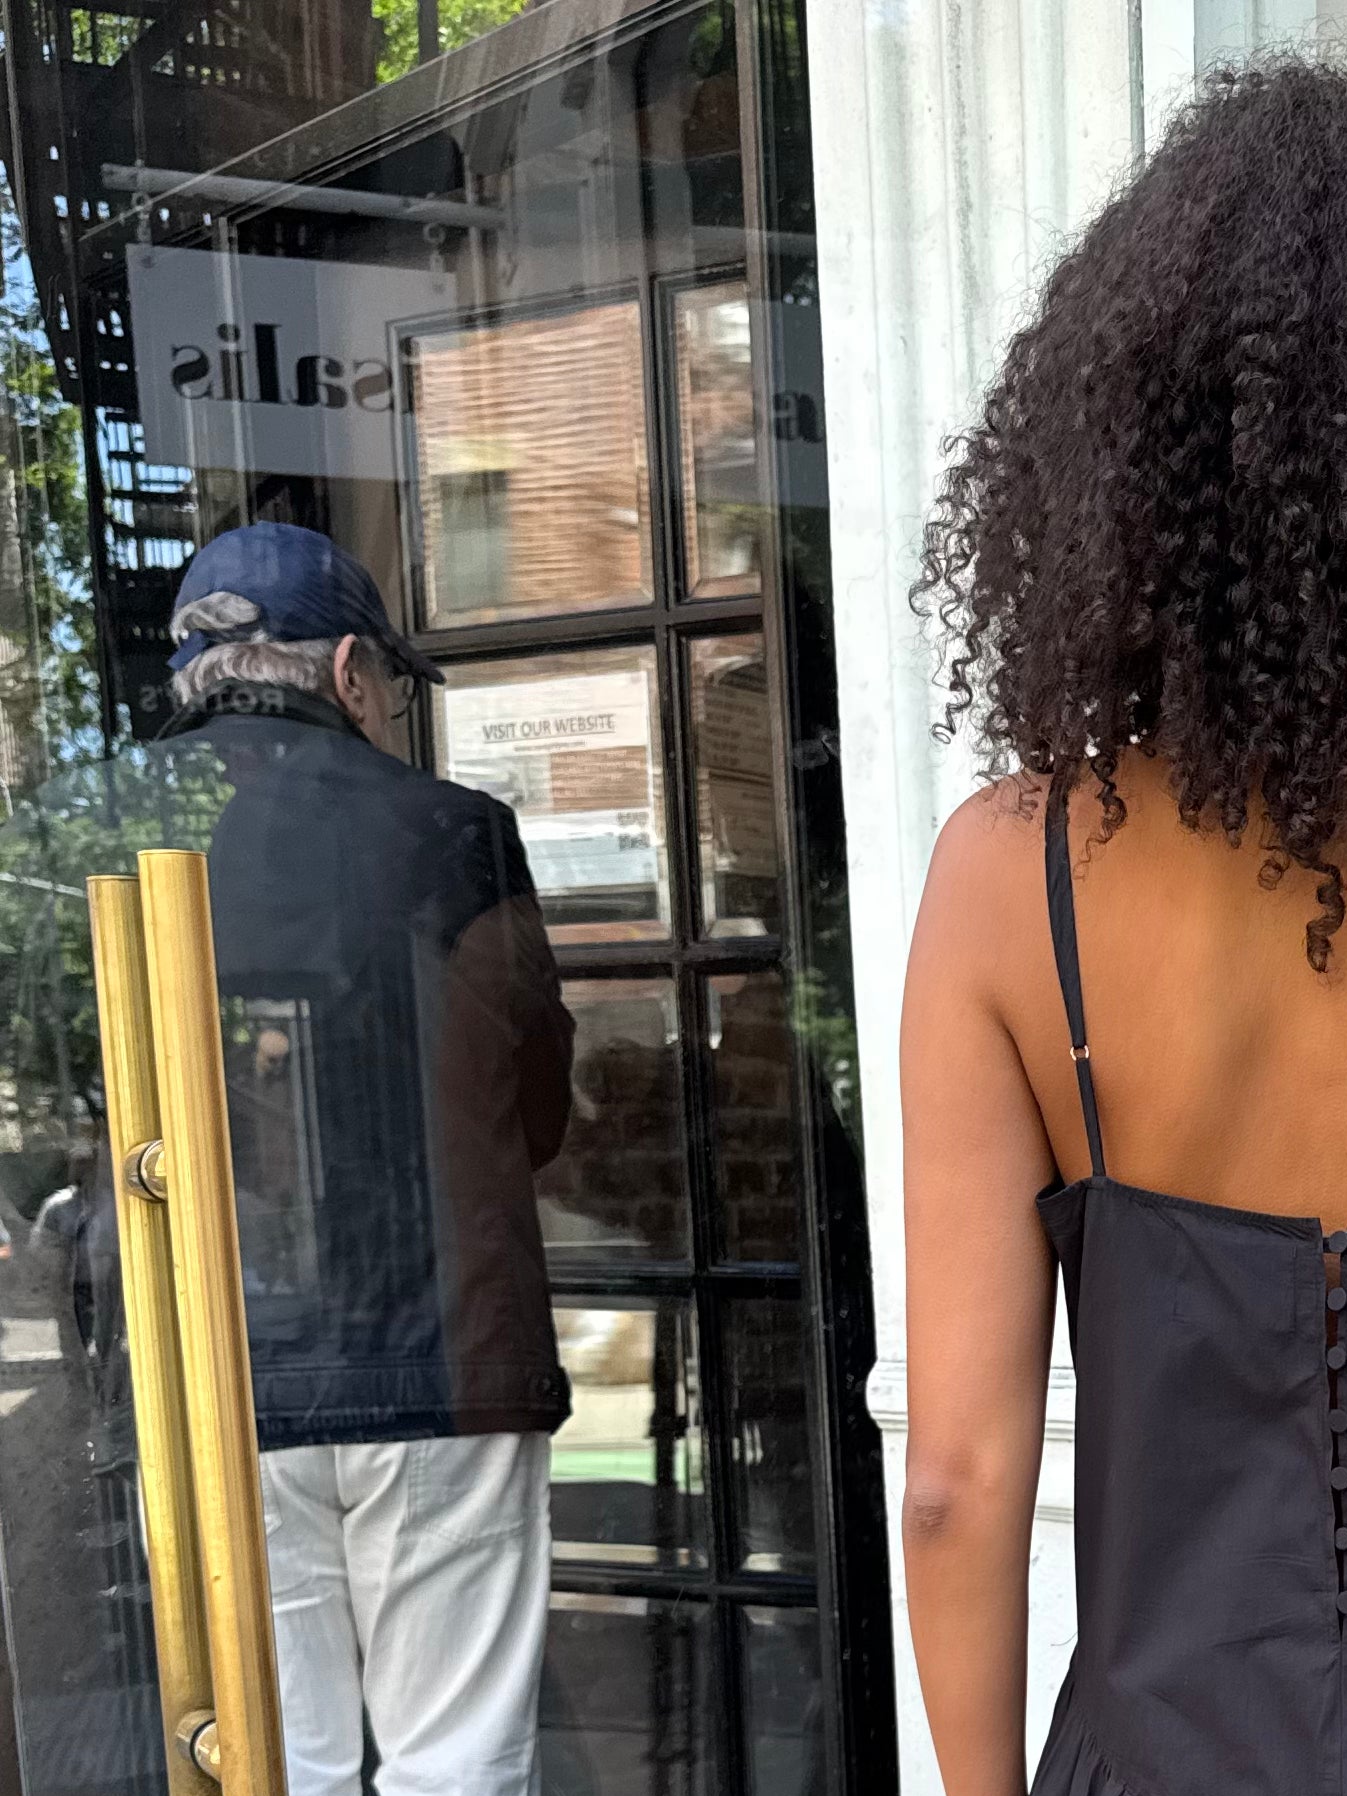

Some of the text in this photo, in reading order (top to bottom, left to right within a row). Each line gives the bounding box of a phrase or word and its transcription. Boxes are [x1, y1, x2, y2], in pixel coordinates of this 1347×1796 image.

[482, 713, 615, 740] VISIT OUR WEBSITE
